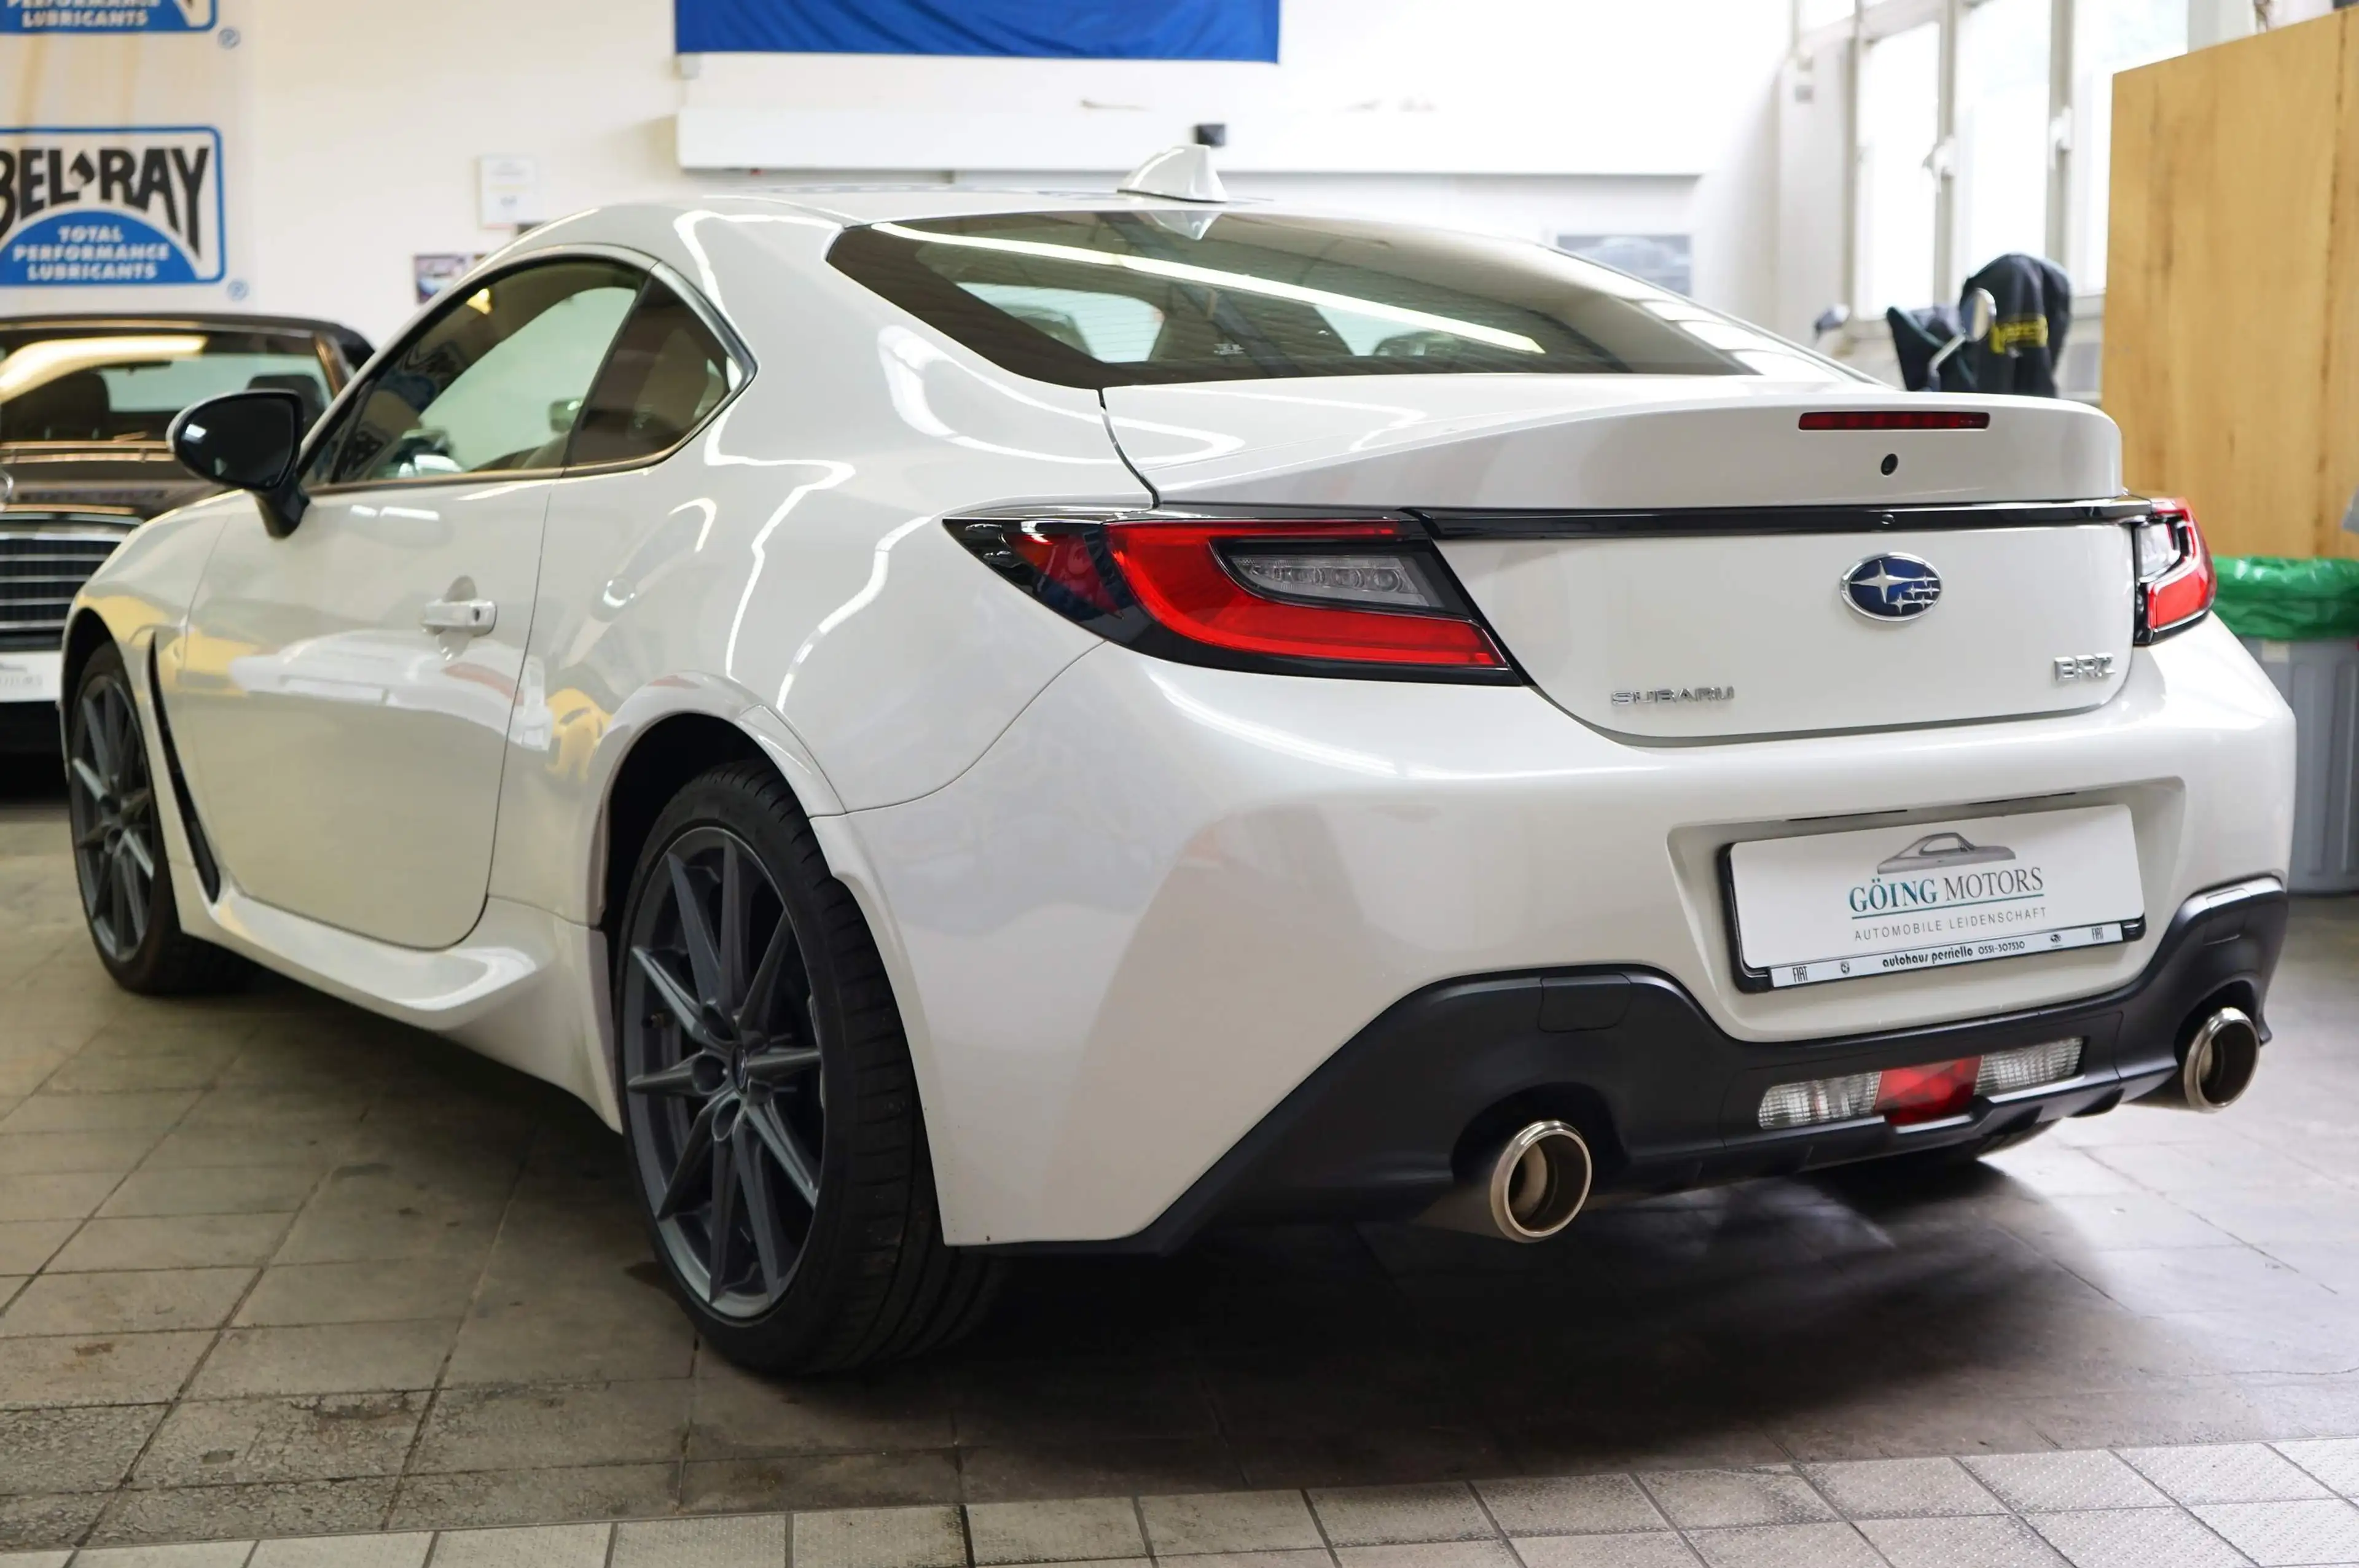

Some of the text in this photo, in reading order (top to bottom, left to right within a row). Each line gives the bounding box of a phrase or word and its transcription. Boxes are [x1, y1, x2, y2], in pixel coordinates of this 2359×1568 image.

[22, 10, 148, 28] LUBRICANTS
[58, 225, 123, 242] TOTAL
[12, 243, 169, 261] PERFORMANCE
[28, 263, 157, 280] LUBRICANTS
[2054, 652, 2115, 681] BRZ
[1612, 686, 1734, 706] SUBARU
[1849, 867, 2044, 912] GÖING MOTORS
[1855, 907, 2046, 942] AUTOMOBILE LEIDENSCHAFT
[1793, 927, 2104, 983] FIAT autohaus perriello 0551-307530 FIAT
